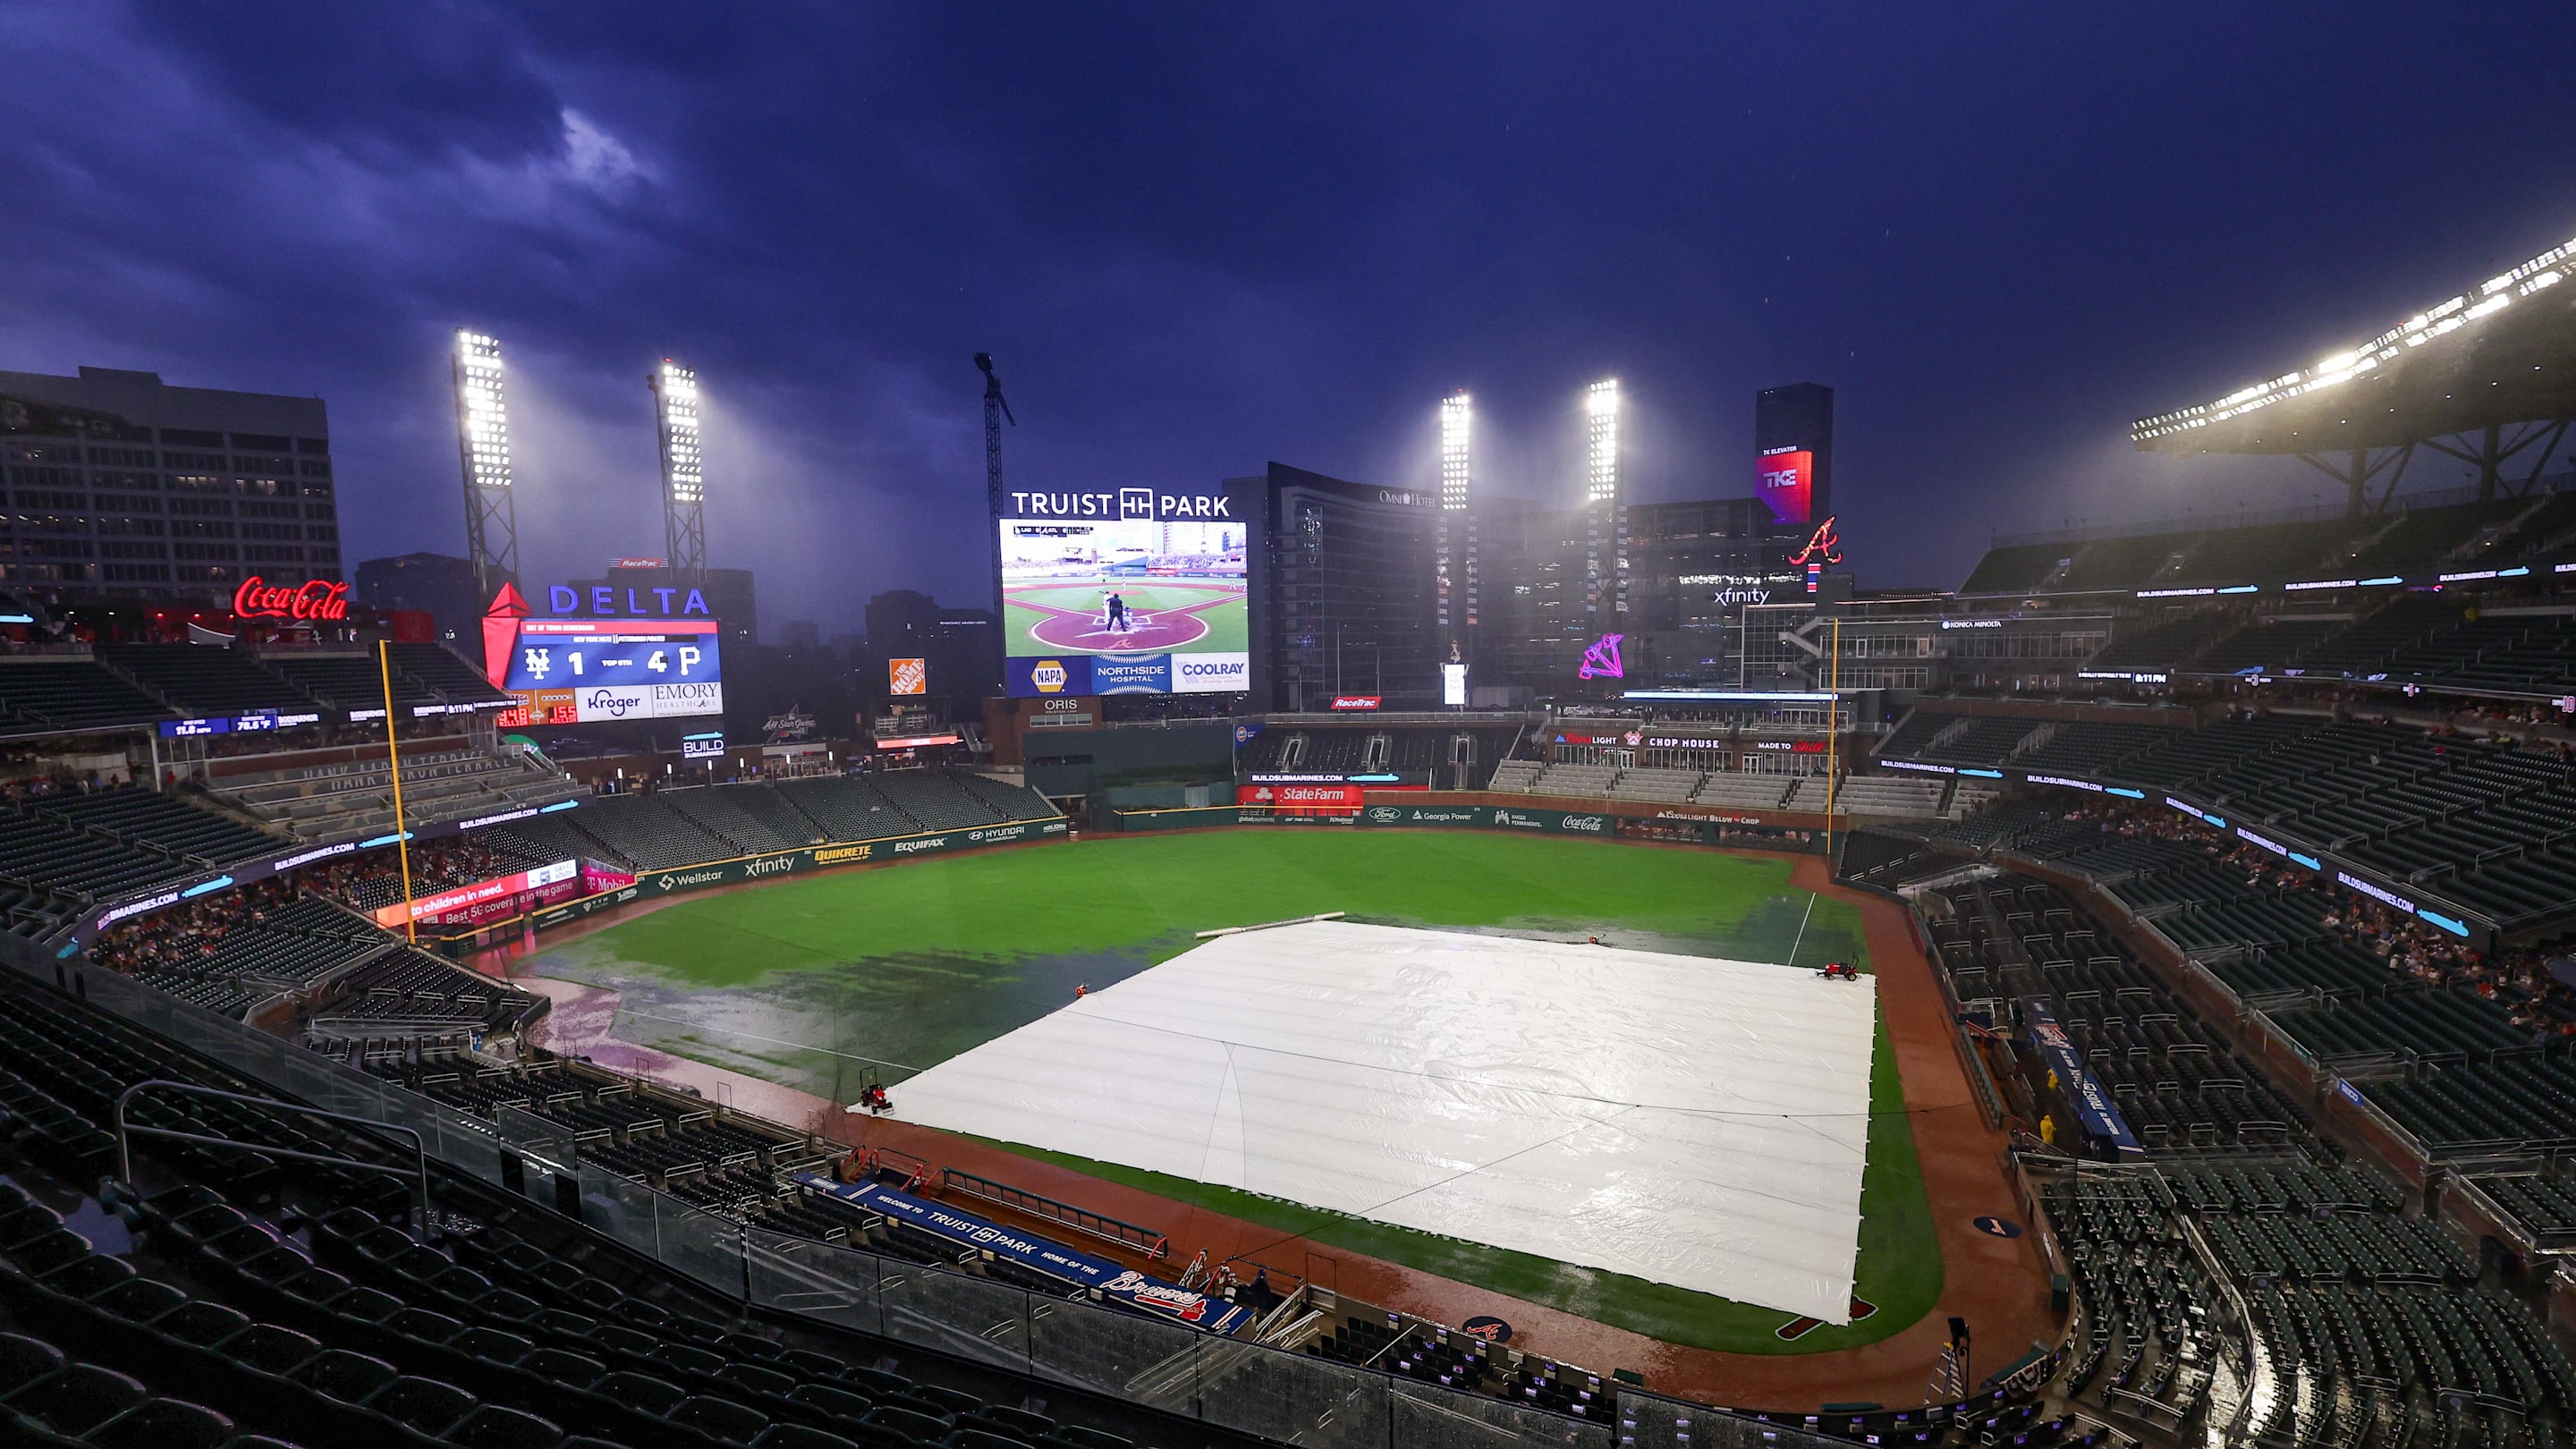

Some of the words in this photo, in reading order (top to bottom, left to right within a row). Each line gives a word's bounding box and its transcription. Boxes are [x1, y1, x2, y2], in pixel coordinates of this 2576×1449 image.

[1771, 445, 1797, 454] ELEVATOR
[1763, 469, 1796, 488] TKE
[1012, 492, 1113, 515] TRUIST
[1161, 496, 1230, 517] PARK
[1379, 490, 1402, 504] OMNI
[622, 559, 657, 568] RaceTrac
[2284, 580, 2357, 590] BUILDSUBMARINES.COM
[234, 575, 350, 620] Coca-Cola
[549, 585, 709, 614] DELTA
[1715, 588, 1770, 606] xfinity
[2137, 589, 2215, 597] BUILDSUBMARINES.COM
[1950, 621, 1973, 629] KONICA
[1974, 620, 2002, 628] MINOLTA
[568, 652, 583, 675] 1
[602, 659, 618, 667] TOP
[648, 651, 667, 673] 4
[894, 663, 908, 676] THE
[1182, 663, 1244, 675] COOLRAY
[891, 659, 923, 694] HOME
[1038, 668, 1063, 682] NAPA
[1097, 666, 1165, 676] NORTHSIDE
[2135, 674, 2152, 682] 8:11
[2153, 674, 2166, 682] PM
[904, 672, 924, 694] DEPOT
[655, 683, 716, 699] EMORY
[449, 705, 462, 714] 8:11
[462, 704, 473, 713] PM
[588, 690, 640, 716] Kroger
[1045, 699, 1077, 709] ORIS
[1335, 699, 1377, 708] RaceTrac
[2562, 696, 2575, 712] 10
[554, 706, 577, 717] 155
[778, 719, 794, 729] Star
[794, 719, 816, 729] Game
[683, 740, 724, 752] BUILD
[1566, 733, 1592, 743] Coors
[1592, 736, 1617, 744] LIGHT
[1649, 738, 1680, 747] CHOP
[1682, 739, 1719, 749] HOUSE
[1792, 741, 1827, 752] Chill
[1881, 760, 1954, 773] BUILDSUBMARINES.COM
[2027, 775, 2102, 792] BUILDSUBMARINES.COM
[1374, 809, 1395, 818] Ford
[2165, 797, 2203, 818] BUILDSUBMARINES.COM
[460, 809, 538, 830] BUILDSUBMARINES.COM
[1424, 812, 1449, 821] Georgia
[1451, 812, 1471, 820] Power
[1562, 815, 1603, 831] Coca-Cola
[1665, 810, 1688, 820] Coors
[1741, 817, 1760, 825] CHOP
[986, 826, 1024, 838] HYUNDAI
[894, 837, 945, 852] EQUIFAX
[2237, 827, 2287, 857] BUILDSUBMARINES.COM
[274, 843, 355, 871] BUILDSUBMARINES.COM
[815, 845, 871, 861] QUIKRETE
[745, 855, 794, 877] xfinity
[587, 877, 595, 890] T
[597, 877, 626, 891] Mobil
[676, 870, 723, 886] Wellstar
[2337, 871, 2414, 913] BUILDSUBMARINES.COM
[411, 905, 422, 917] to
[424, 894, 466, 913] children
[467, 891, 477, 902] in
[479, 885, 504, 900] need.
[446, 911, 468, 926] Best
[470, 904, 483, 919] 5G
[526, 892, 534, 902] in
[536, 887, 549, 900] the
[550, 881, 573, 896] game
[877, 1194, 913, 1211] WELCOME
[911, 1207, 924, 1215] TO
[928, 1211, 979, 1234] TRUIST
[993, 1234, 1038, 1256] PARK
[1041, 1251, 1067, 1265] HOME
[1067, 1260, 1080, 1269] OF
[1080, 1264, 1100, 1275] THE
[1099, 1270, 1204, 1305] Braves
